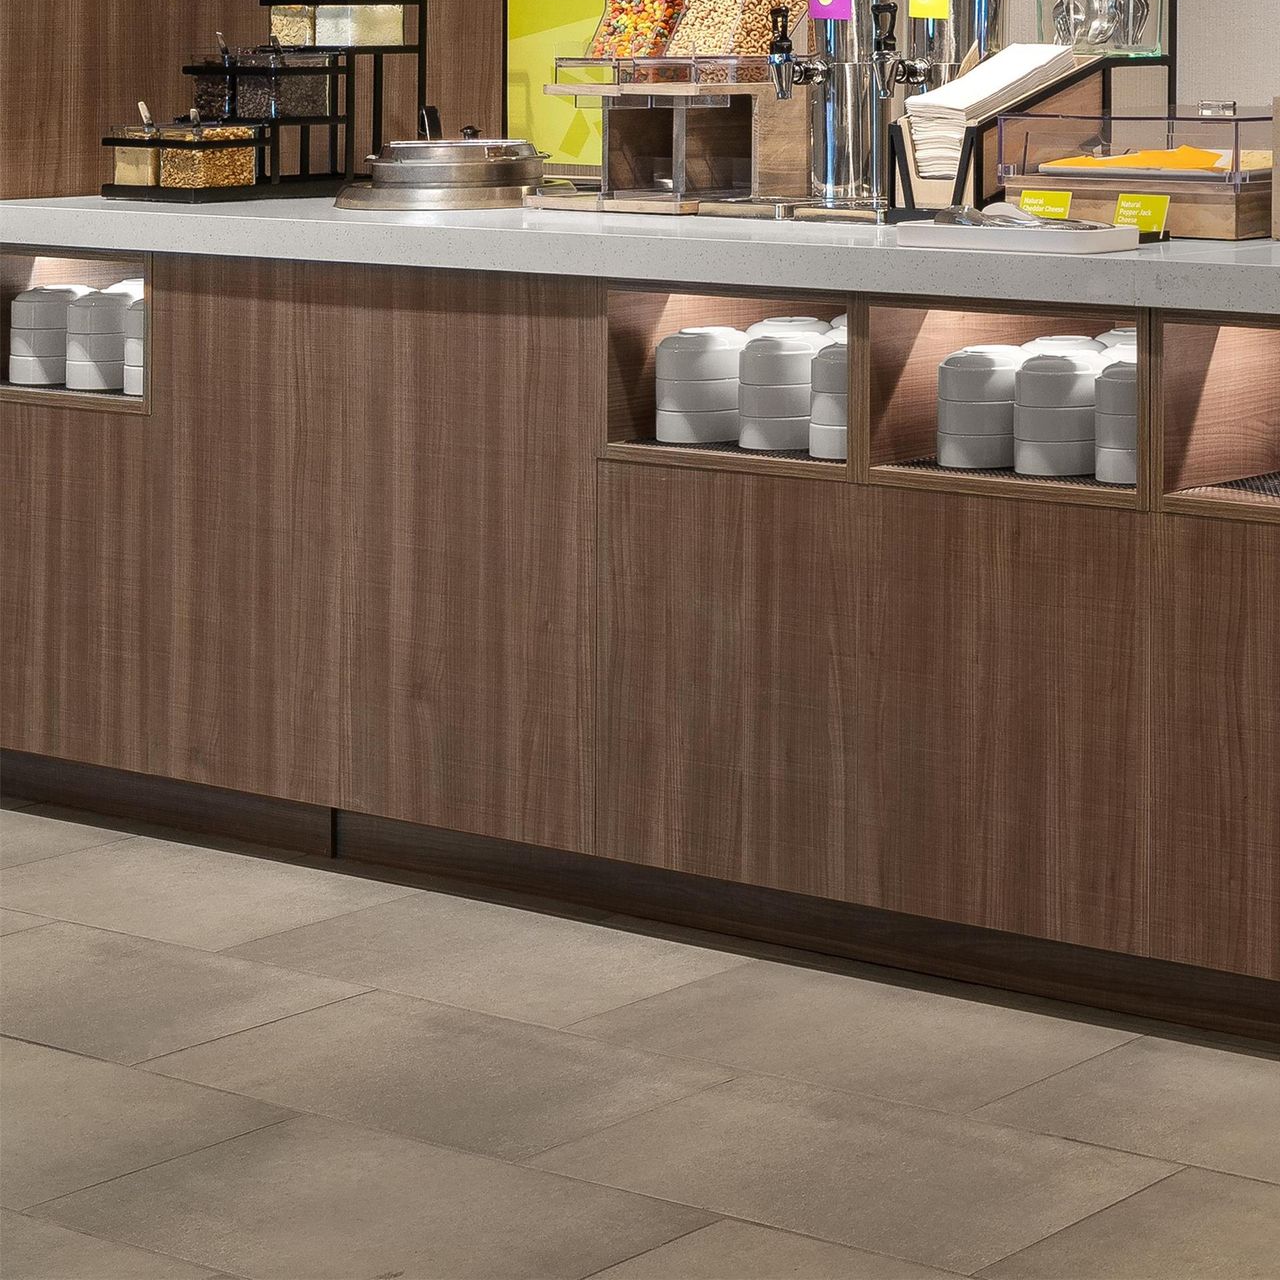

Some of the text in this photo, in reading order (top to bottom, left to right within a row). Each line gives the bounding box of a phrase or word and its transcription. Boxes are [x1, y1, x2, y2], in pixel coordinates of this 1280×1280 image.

[1120, 200, 1141, 208] Natural
[1023, 205, 1044, 213] Cheddar
[1119, 208, 1138, 217] Pepper
